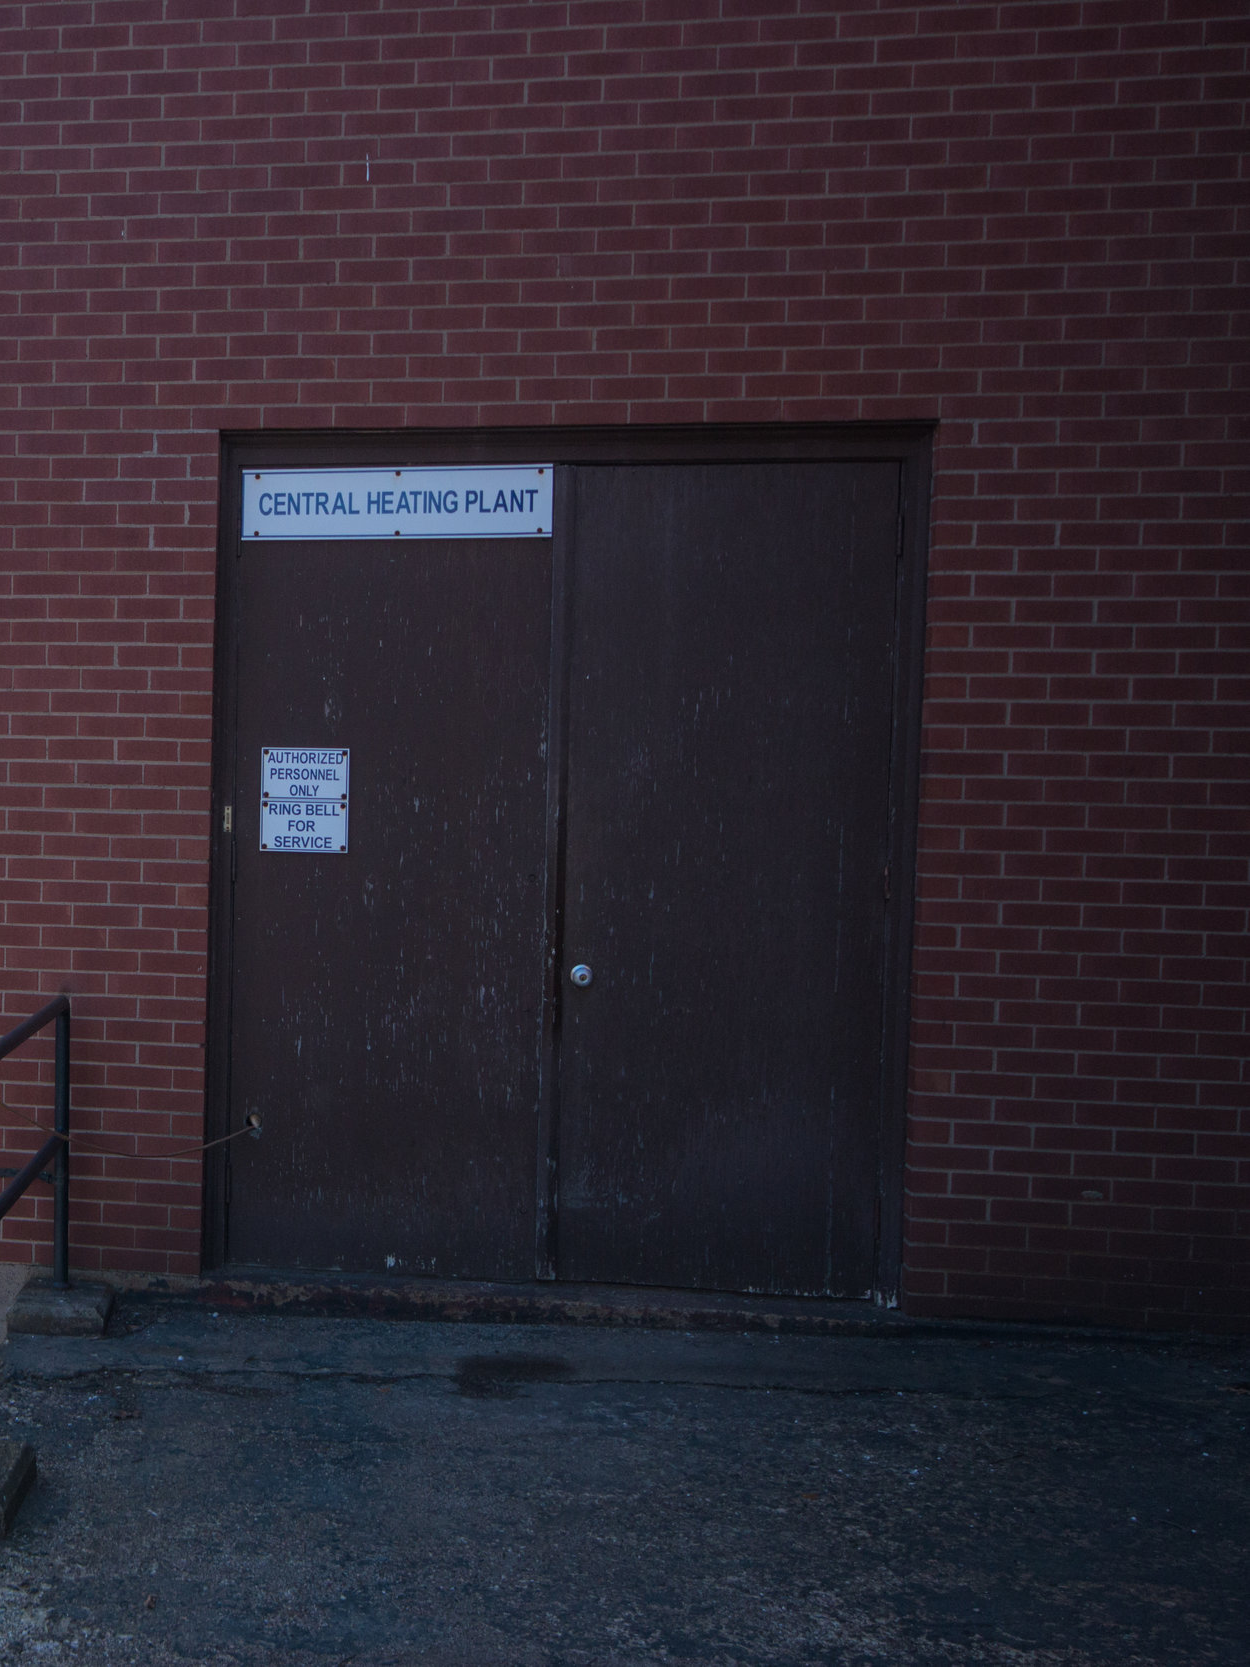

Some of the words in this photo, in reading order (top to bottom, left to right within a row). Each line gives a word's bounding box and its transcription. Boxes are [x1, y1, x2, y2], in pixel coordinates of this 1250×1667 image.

[258, 492, 360, 516] CENTRAL
[367, 490, 458, 515] HEATING
[465, 489, 539, 514] PLANT
[268, 752, 343, 764] AUTHORIZED
[270, 768, 340, 780] PERSONNEL
[290, 785, 319, 796] ONLY
[269, 804, 301, 815] RING
[305, 804, 340, 816] BELL
[288, 820, 315, 831] FOR
[274, 836, 332, 848] SERVICE
